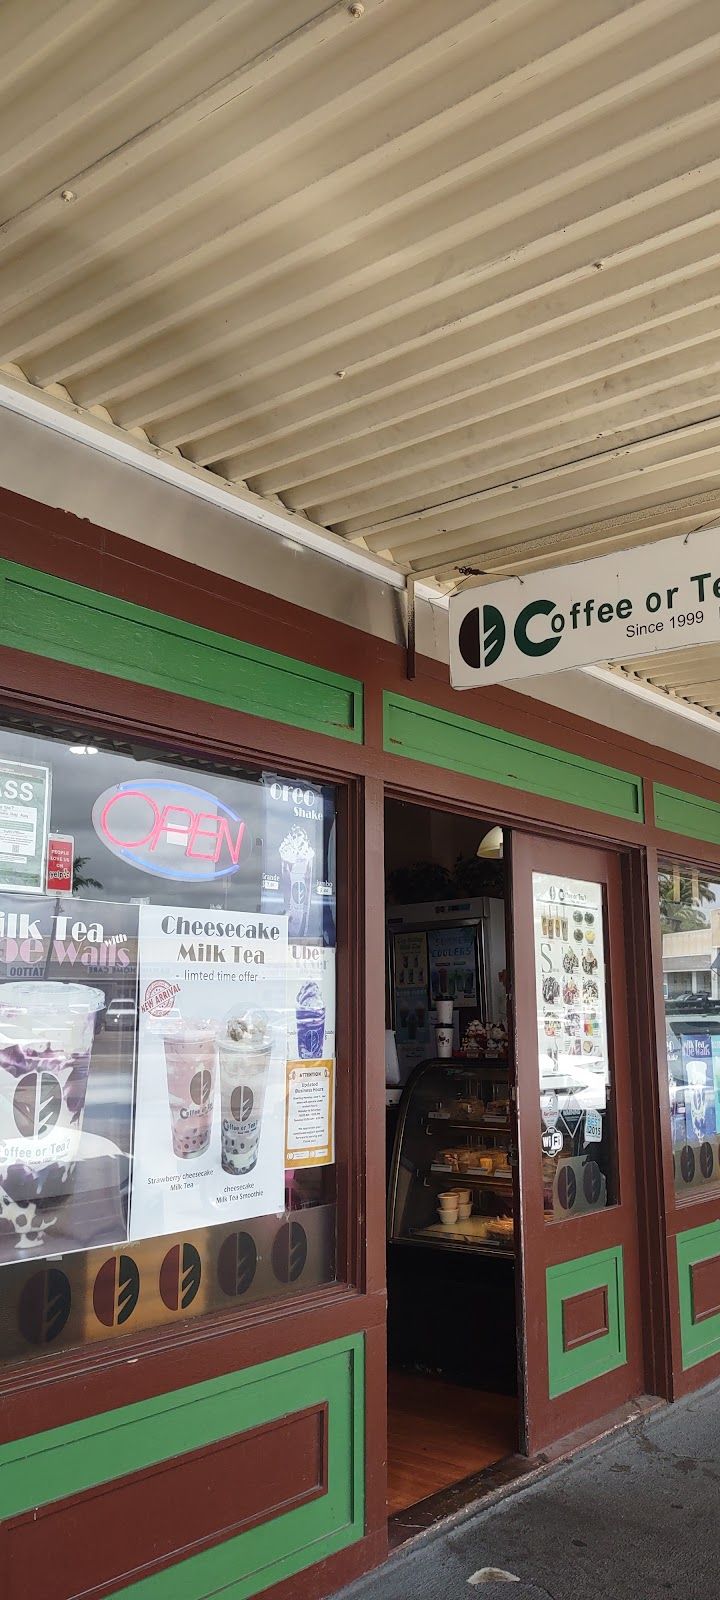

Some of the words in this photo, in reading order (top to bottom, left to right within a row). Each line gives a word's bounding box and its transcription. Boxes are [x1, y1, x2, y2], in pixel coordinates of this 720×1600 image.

[514, 599, 633, 657] Coffee
[645, 587, 678, 613] or
[626, 619, 664, 638] Since
[669, 610, 704, 629] 1999
[0, 780, 33, 802] SS
[101, 790, 246, 865] OPEN
[51, 916, 103, 943] Tea
[104, 933, 128, 948] with
[161, 915, 280, 940] Cheesecake
[53, 941, 130, 968] Walls
[177, 943, 226, 962] Milk
[231, 945, 265, 964] Tea
[184, 969, 214, 981] limted
[217, 970, 236, 981] time
[238, 971, 258, 982] offer
[154, 983, 181, 1001] ARRIVAL
[35, 1148, 47, 1156] or
[50, 1139, 70, 1155] Tea?
[147, 1174, 182, 1185] Strawberry
[182, 1169, 214, 1180] cheesecake
[169, 1183, 183, 1191] Milk
[223, 1182, 255, 1193] cheesecake
[229, 1194, 239, 1202] Tea
[239, 1190, 264, 1200] Smoothie
